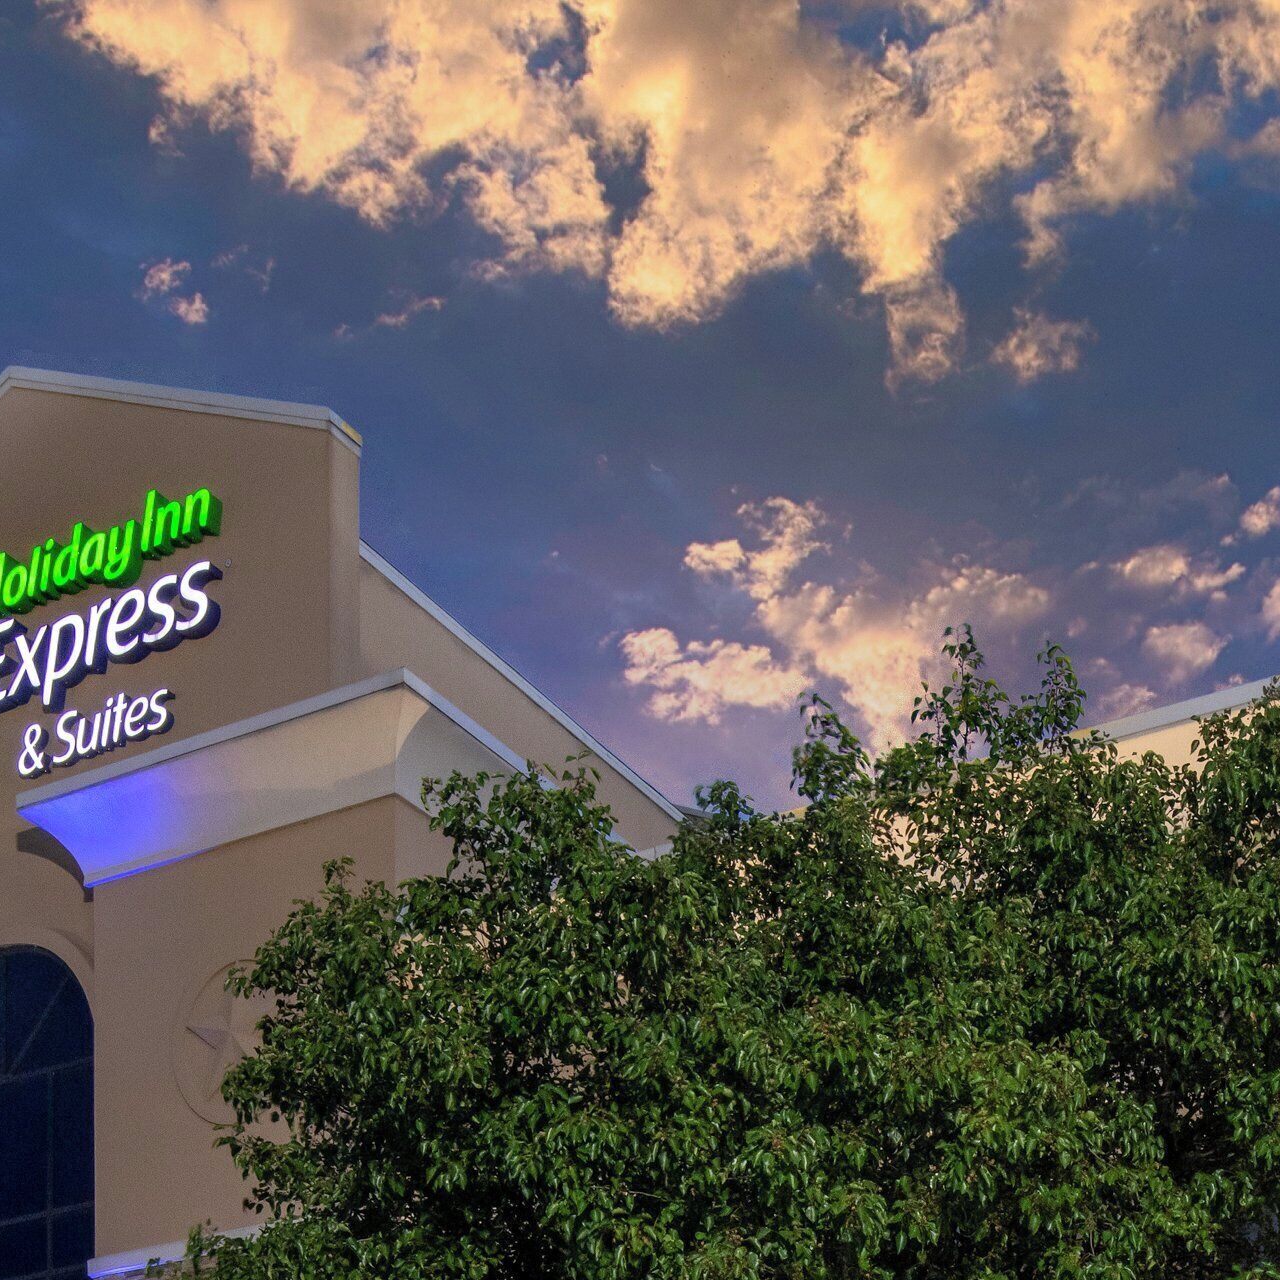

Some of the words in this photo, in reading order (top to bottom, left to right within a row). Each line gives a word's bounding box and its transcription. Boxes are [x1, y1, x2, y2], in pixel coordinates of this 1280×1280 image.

[140, 487, 215, 555] Inn
[18, 722, 46, 776] &
[51, 688, 170, 764] Suites
